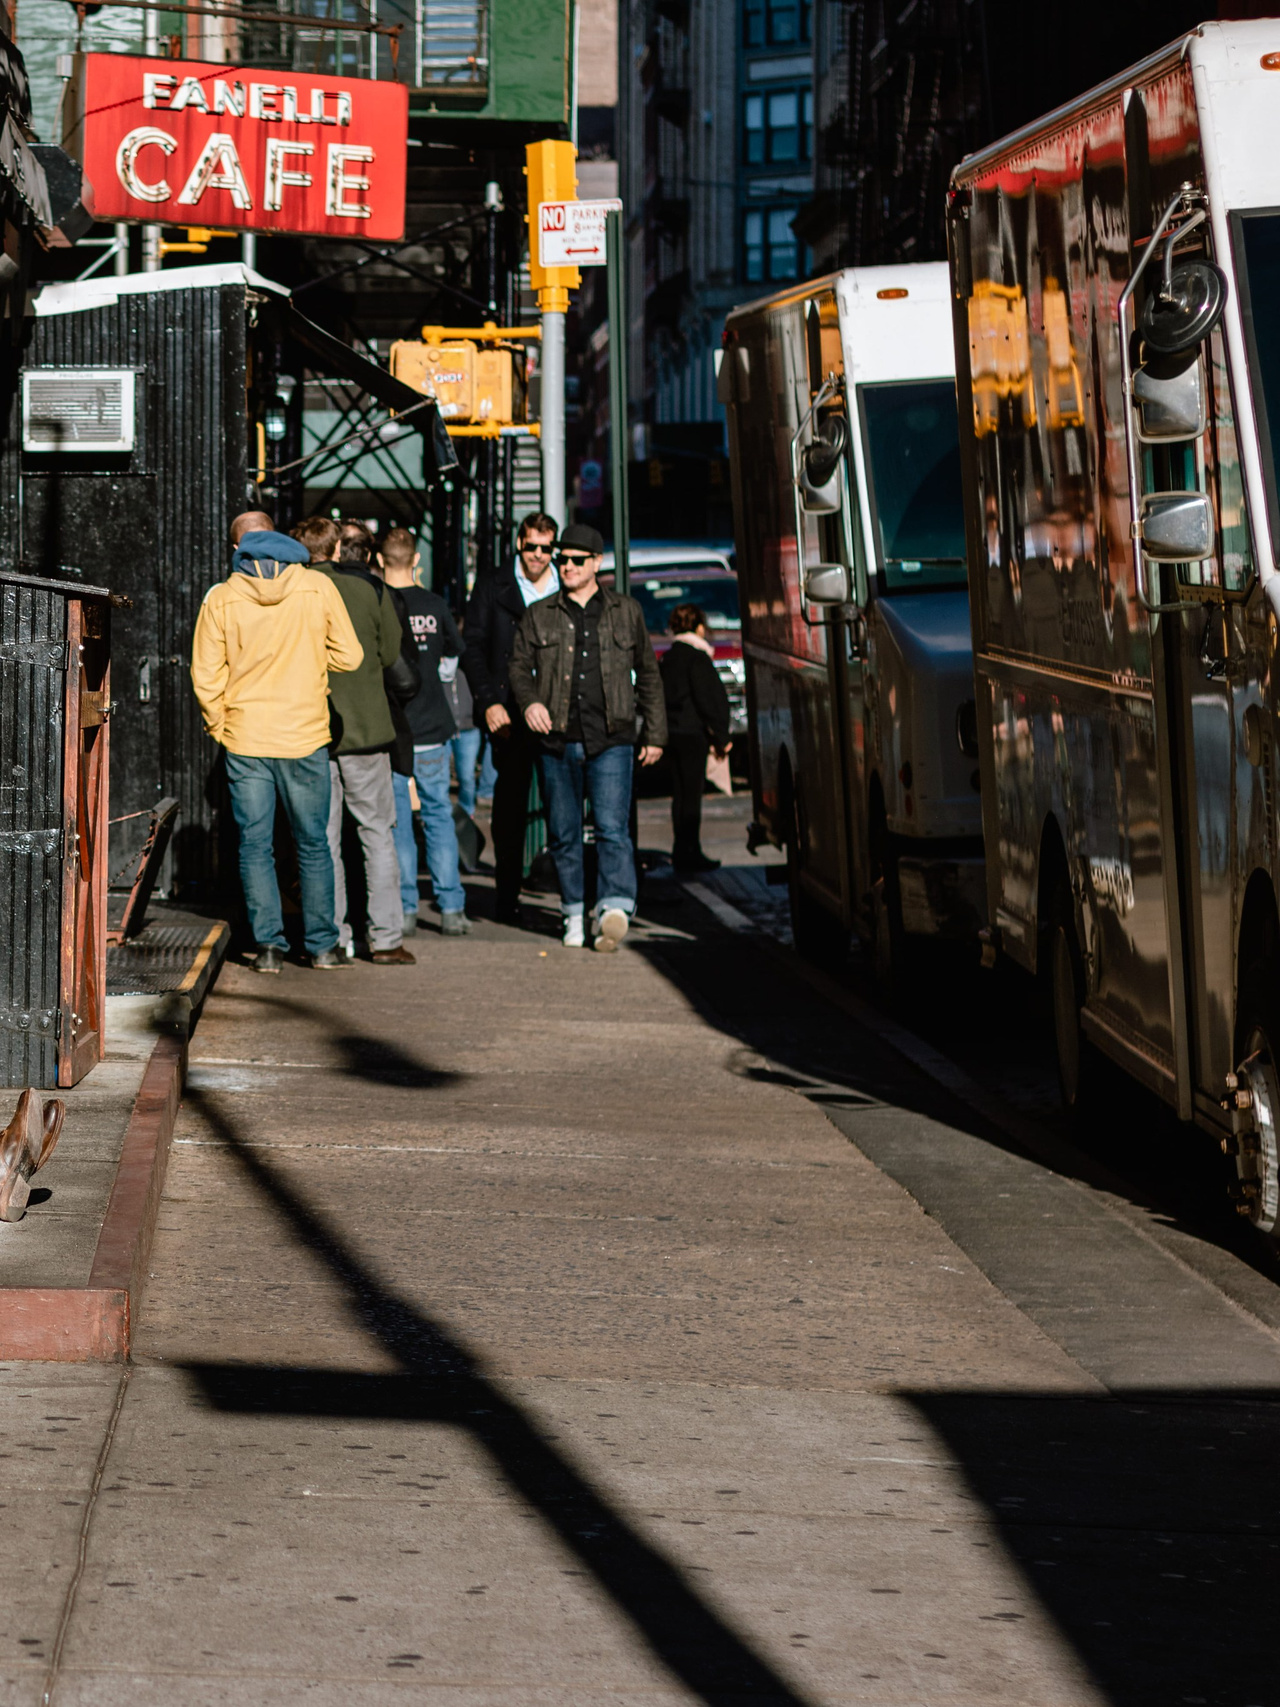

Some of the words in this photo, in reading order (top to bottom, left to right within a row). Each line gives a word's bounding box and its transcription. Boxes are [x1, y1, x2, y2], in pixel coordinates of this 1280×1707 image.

[143, 72, 352, 126] FANELLI
[116, 126, 375, 219] CAFE
[543, 206, 565, 231] NO
